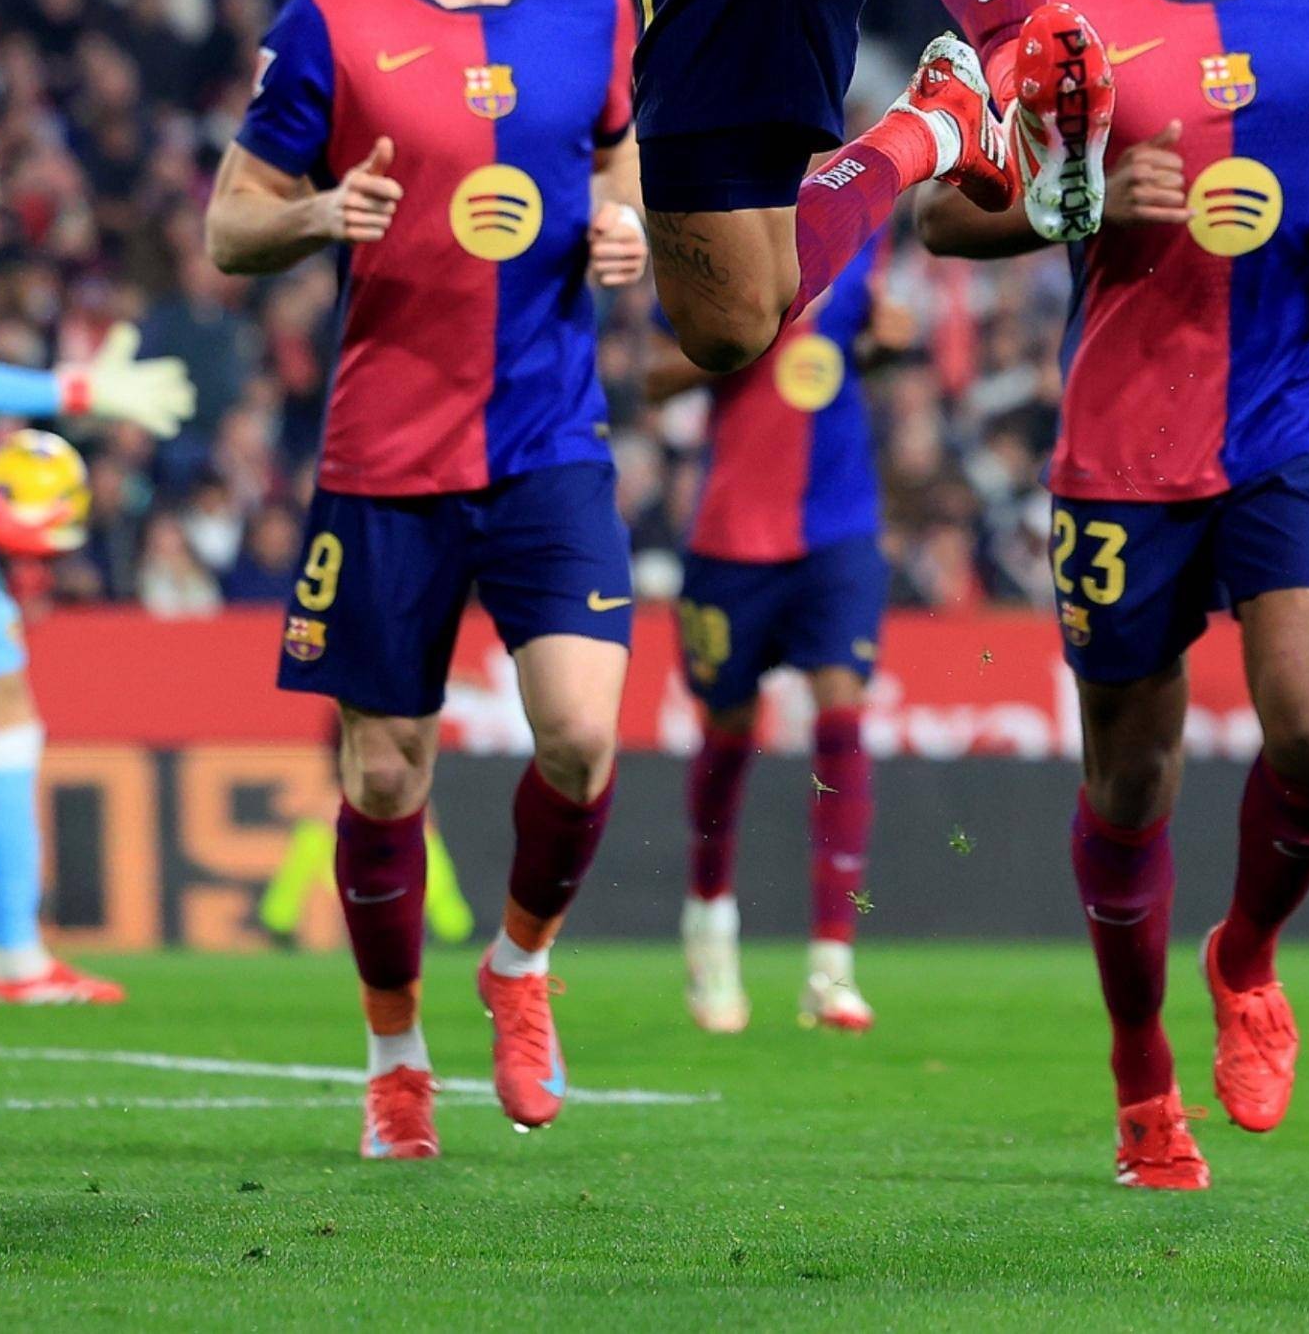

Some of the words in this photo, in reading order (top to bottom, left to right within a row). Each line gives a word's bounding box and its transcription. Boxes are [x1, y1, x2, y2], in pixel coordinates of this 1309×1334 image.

[1053, 28, 1092, 239] PREDATOR
[295, 531, 344, 612] 9
[1053, 509, 1128, 605] 23
